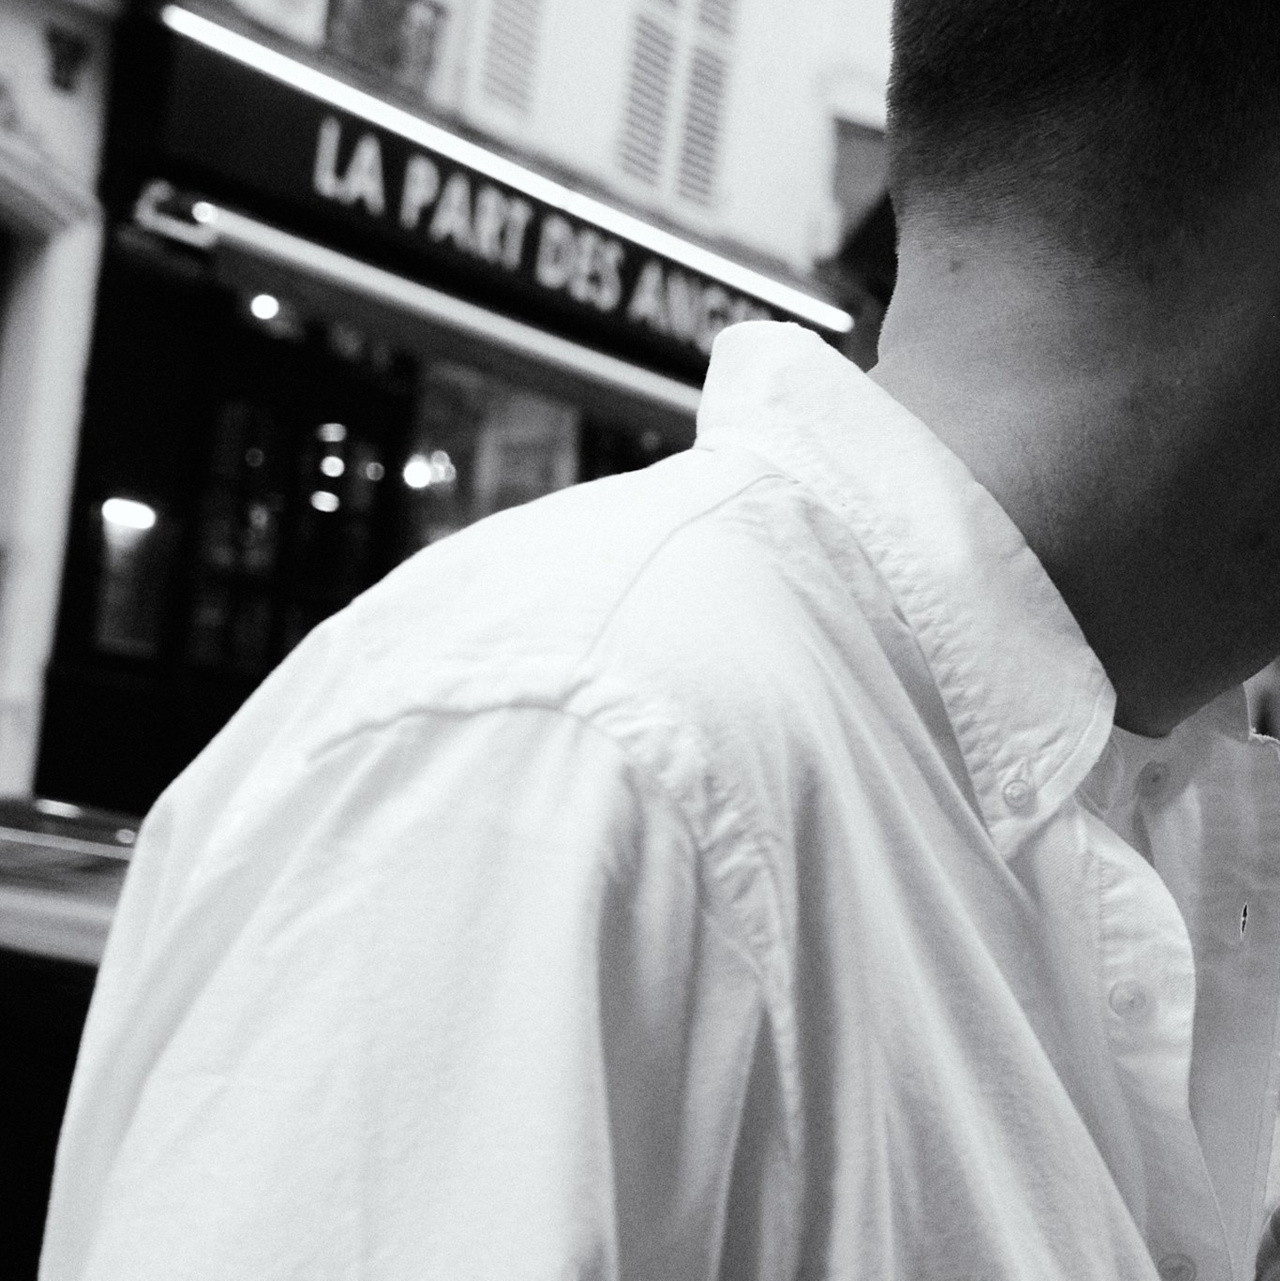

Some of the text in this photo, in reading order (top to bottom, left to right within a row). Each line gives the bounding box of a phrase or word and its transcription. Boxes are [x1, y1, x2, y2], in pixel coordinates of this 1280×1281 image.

[313, 117, 772, 356] LA PART DES ANG
